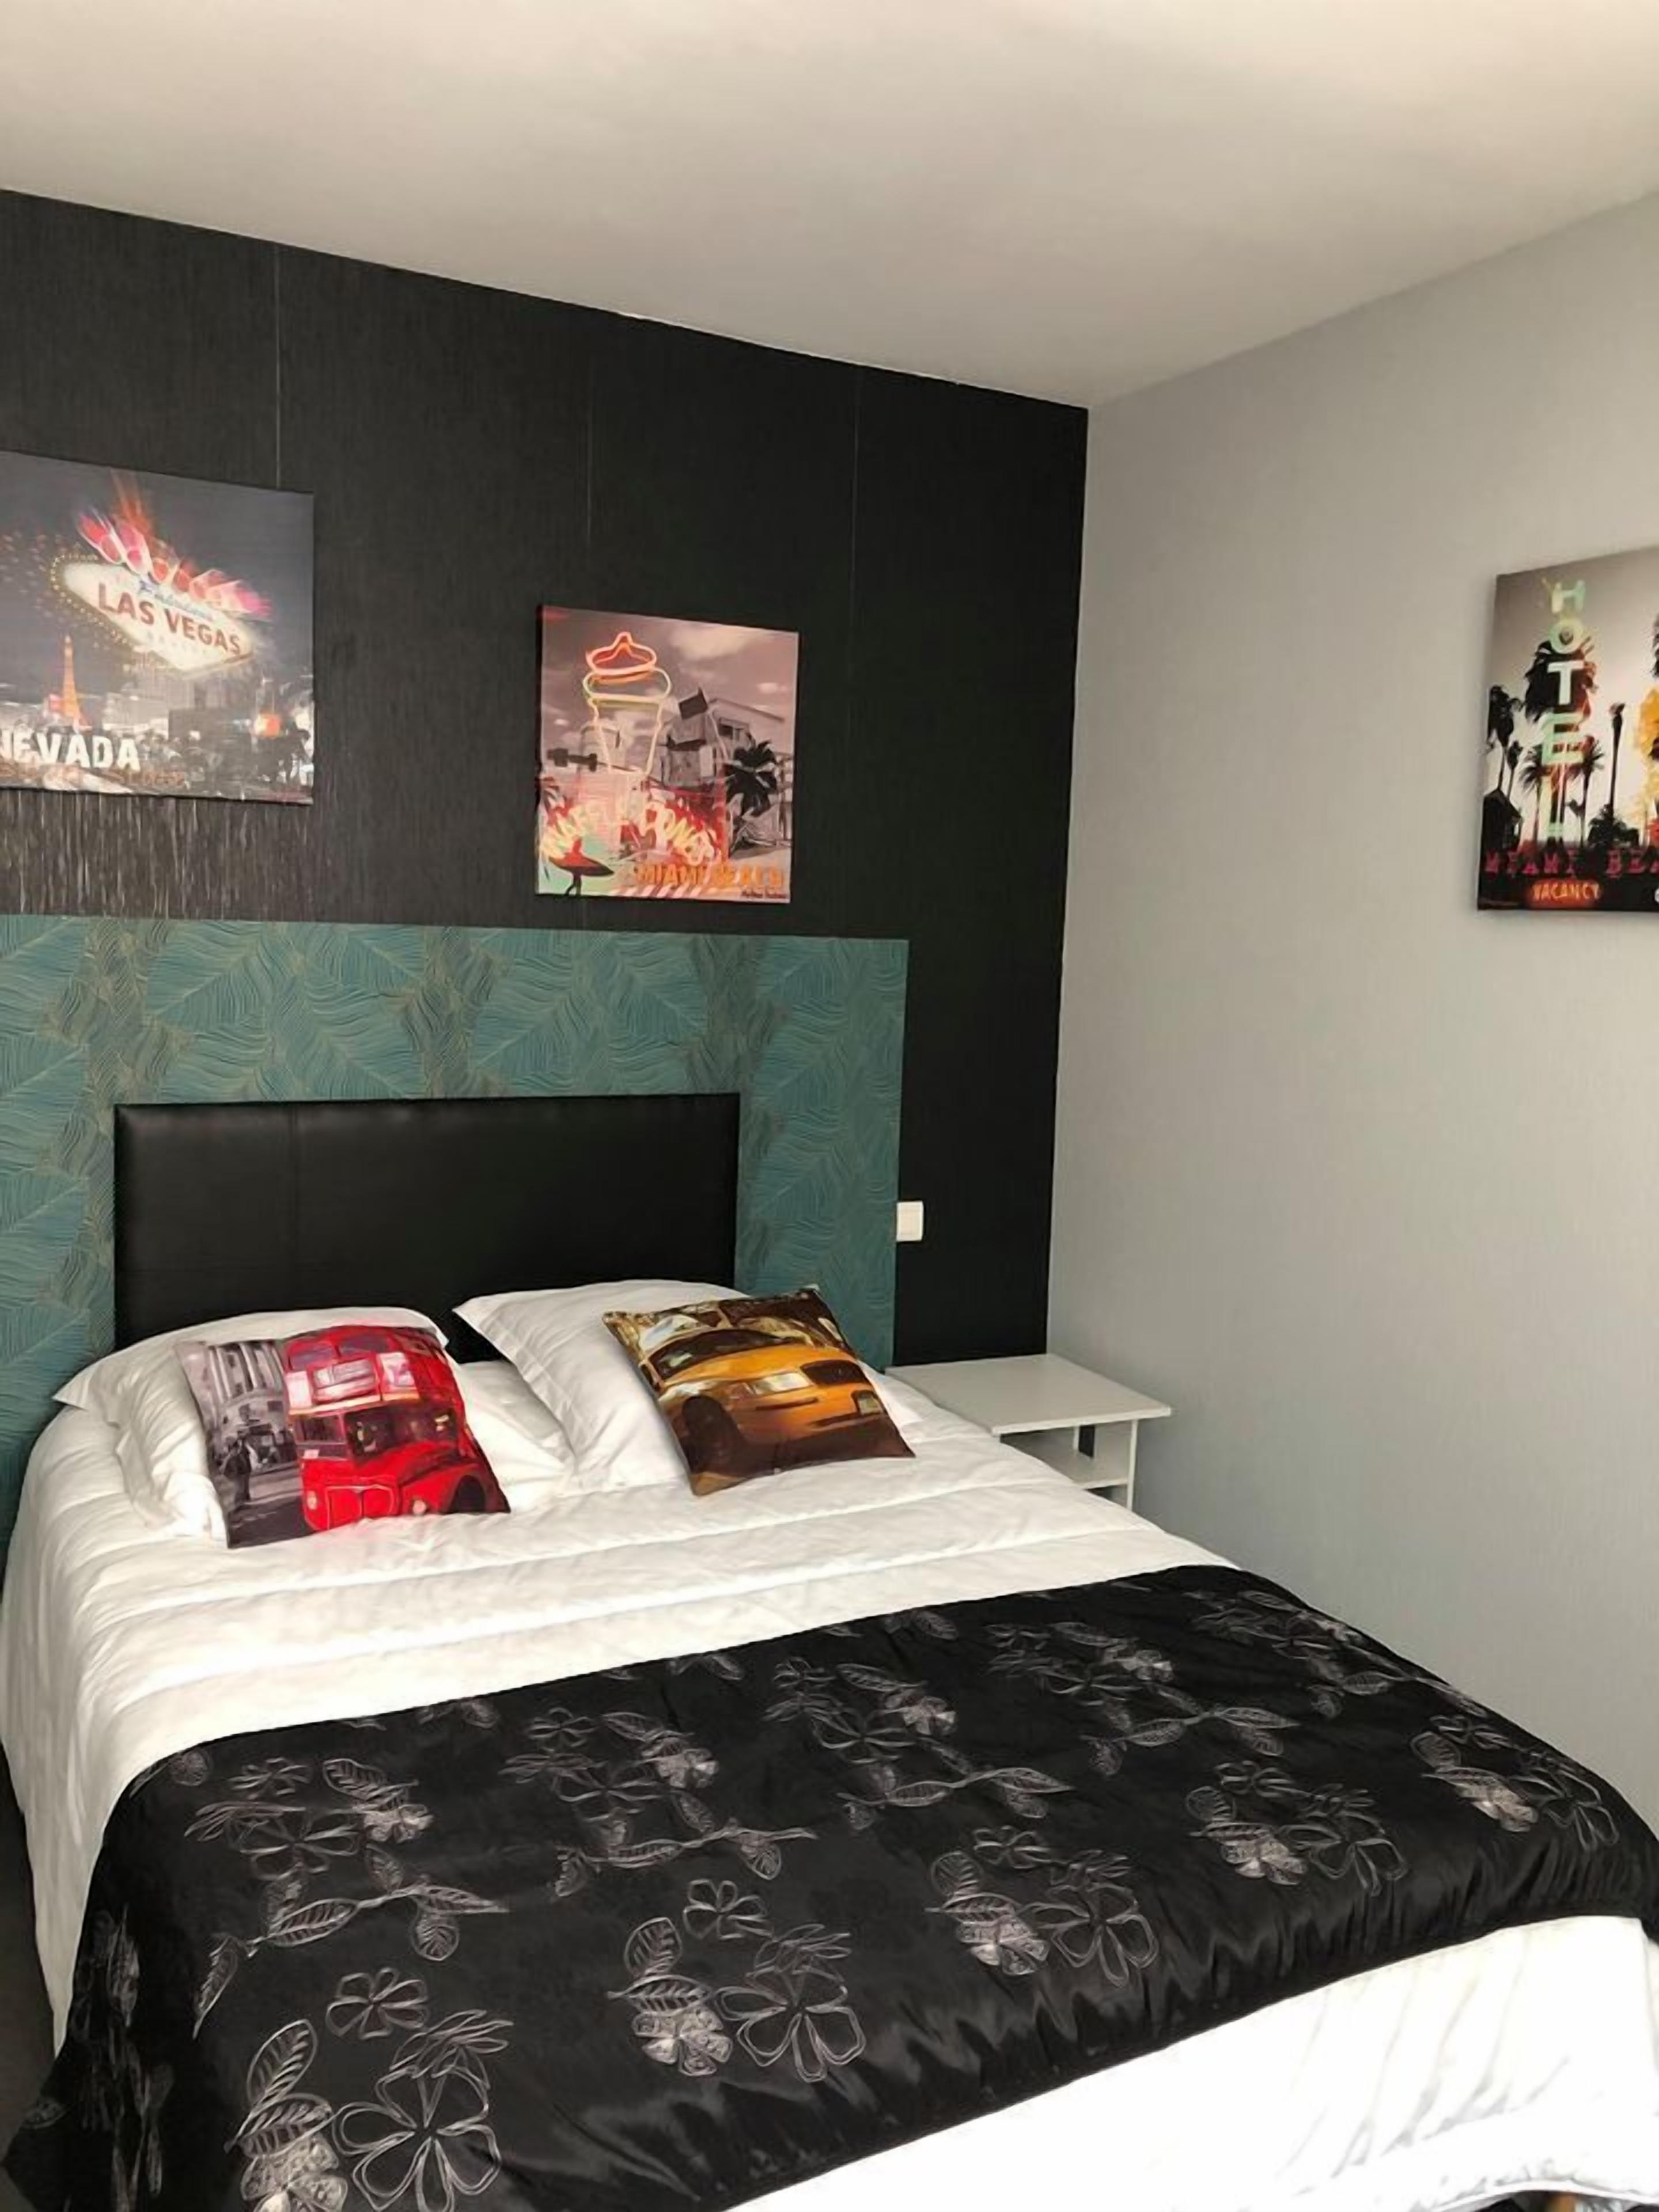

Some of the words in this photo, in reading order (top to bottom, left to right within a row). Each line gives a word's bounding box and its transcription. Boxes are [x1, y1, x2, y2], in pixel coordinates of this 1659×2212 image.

[99, 583, 154, 625] LAS
[164, 608, 241, 655] VEGAS
[1532, 881, 1600, 901] VACANCY
